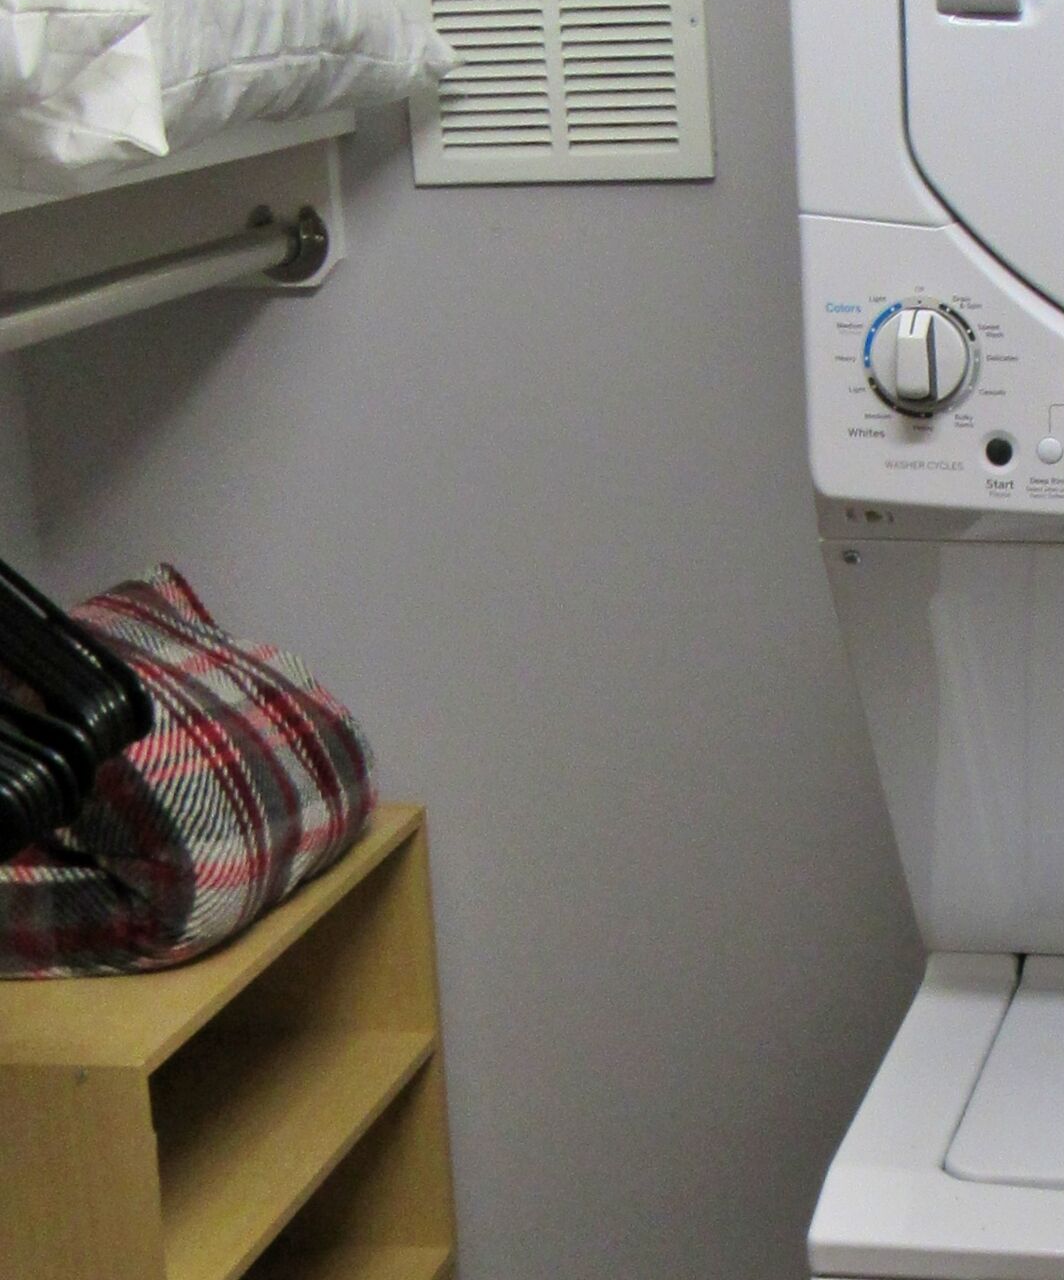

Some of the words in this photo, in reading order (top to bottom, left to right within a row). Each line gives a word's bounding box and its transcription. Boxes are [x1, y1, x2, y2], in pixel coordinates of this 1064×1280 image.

[868, 295, 888, 305] Light
[825, 302, 862, 314] Colors
[848, 385, 867, 394] Light
[848, 427, 885, 439] Whites
[885, 460, 925, 471] WASHER
[927, 460, 964, 471] CYCLES
[985, 478, 1014, 490] Start
